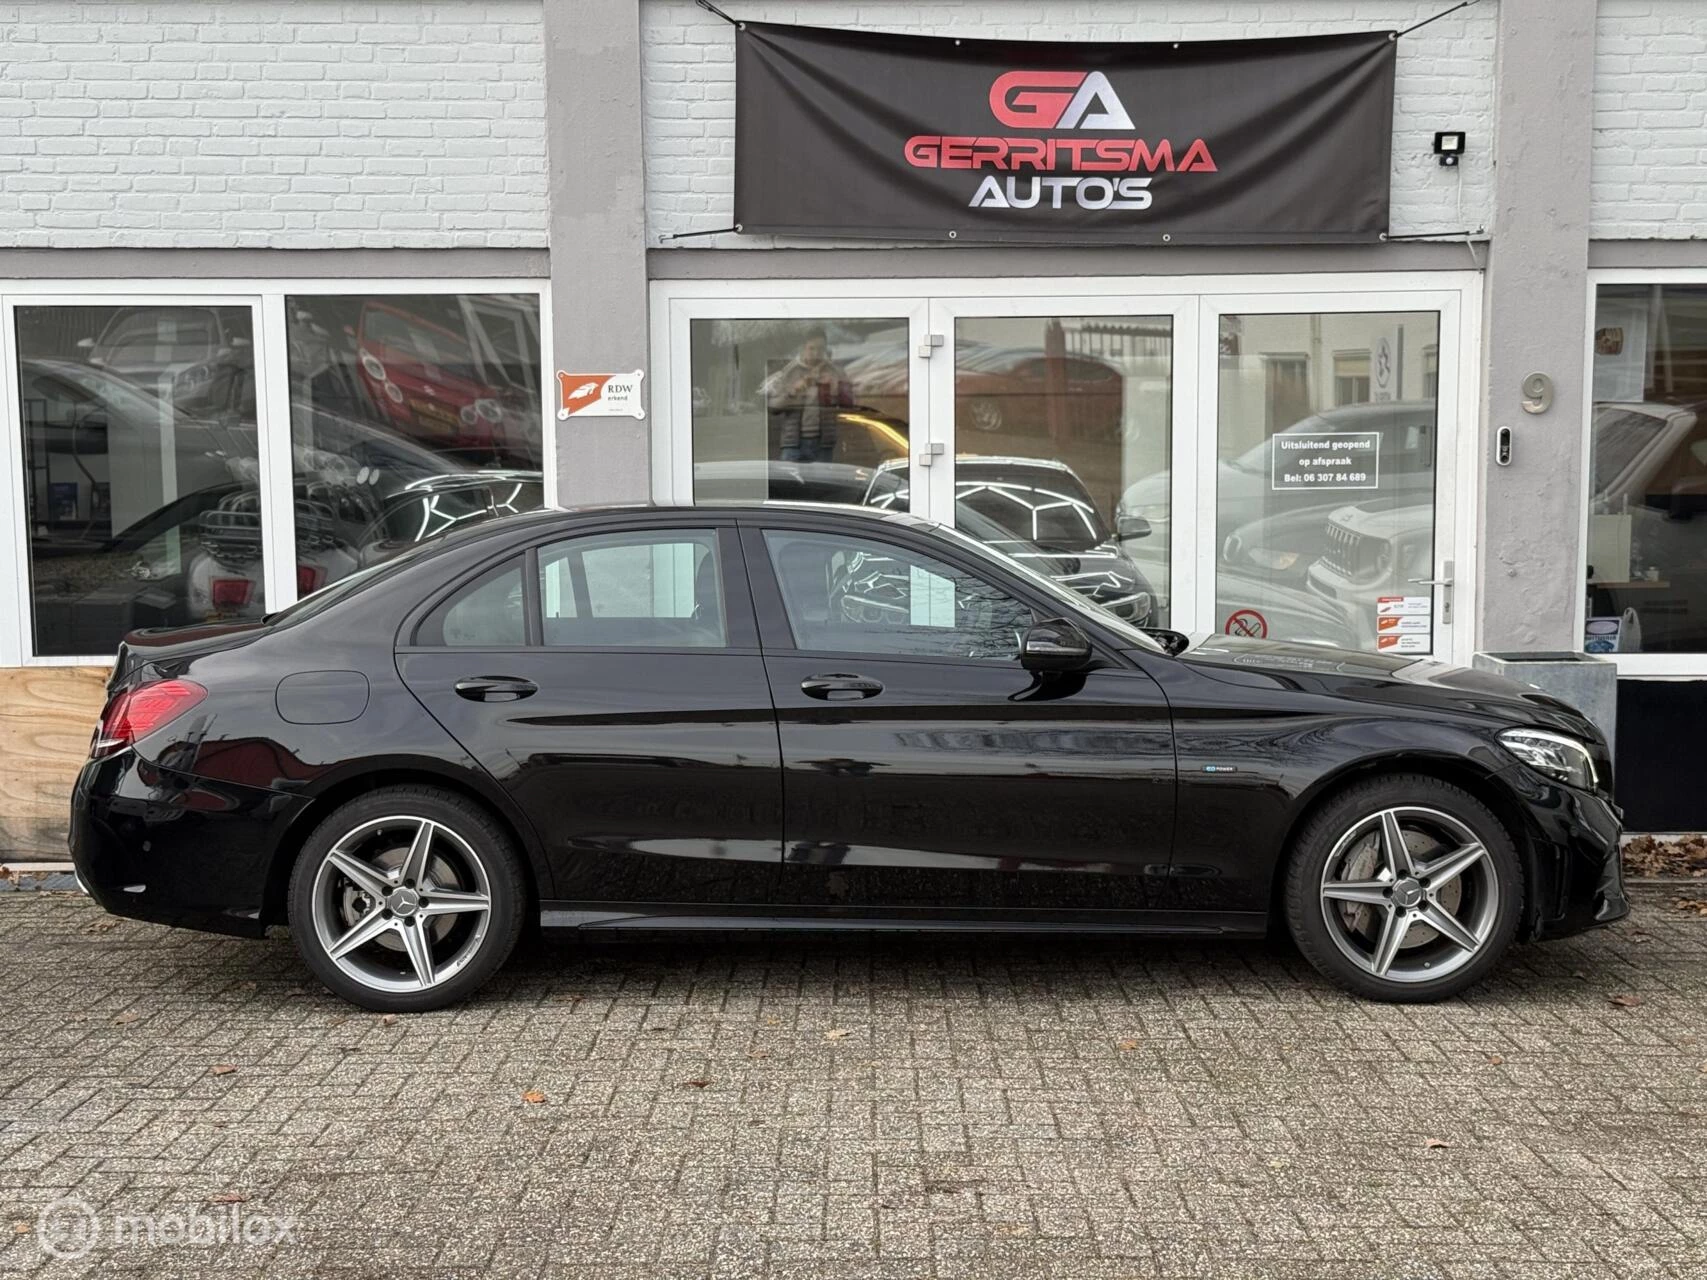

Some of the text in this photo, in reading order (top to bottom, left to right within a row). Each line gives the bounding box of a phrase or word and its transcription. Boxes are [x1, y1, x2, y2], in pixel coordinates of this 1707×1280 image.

[989, 71, 1136, 130] GA
[904, 135, 1219, 172] GERRITSMA
[968, 175, 1153, 210] AUTO'S
[607, 384, 633, 394] RDW
[1521, 371, 1553, 415] 9
[1281, 440, 1371, 450] Uitsluitend geopend
[1298, 457, 1352, 467] op afspraak
[1284, 473, 1366, 482] Bel: 06 307 84 689
